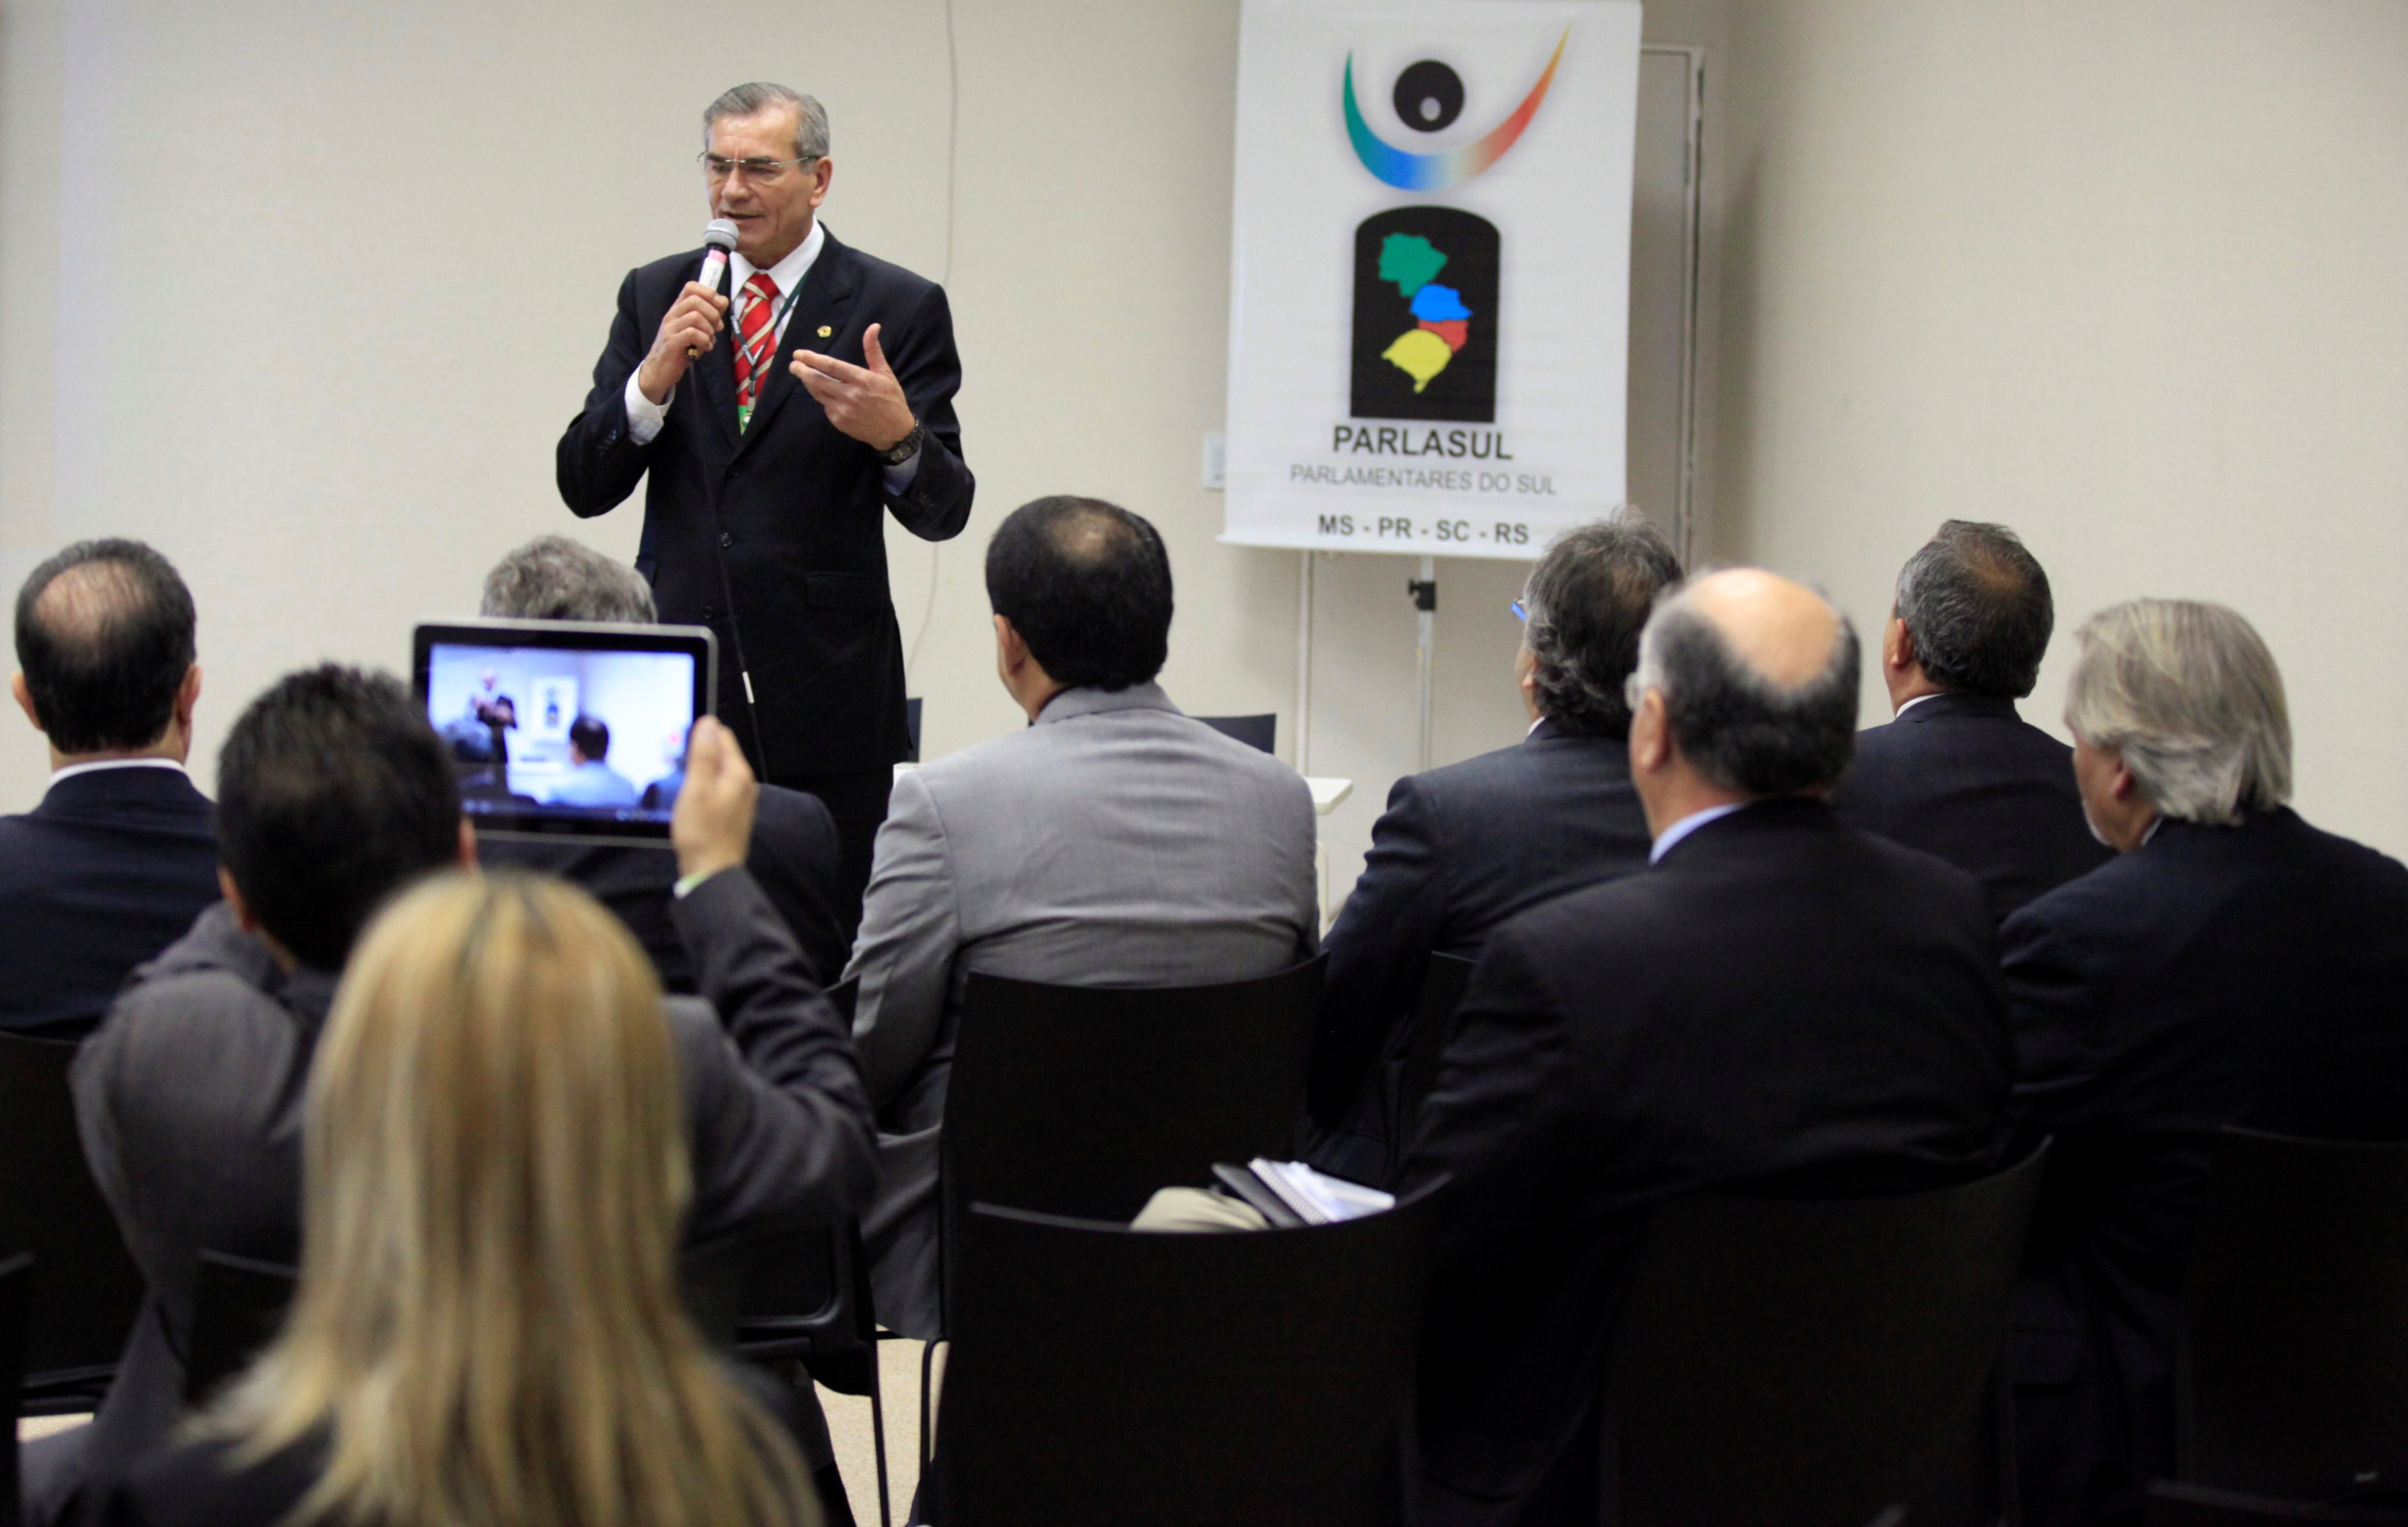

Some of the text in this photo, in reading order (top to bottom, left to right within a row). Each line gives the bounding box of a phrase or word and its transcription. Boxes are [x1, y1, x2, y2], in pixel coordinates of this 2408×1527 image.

[1333, 425, 1514, 459] PARLASUL
[1291, 465, 1556, 495] PARLAMENTARES DO SUL
[1319, 516, 1354, 536] MS
[1379, 518, 1411, 539] PR
[1436, 520, 1469, 541] SC
[1495, 524, 1529, 544] RS
